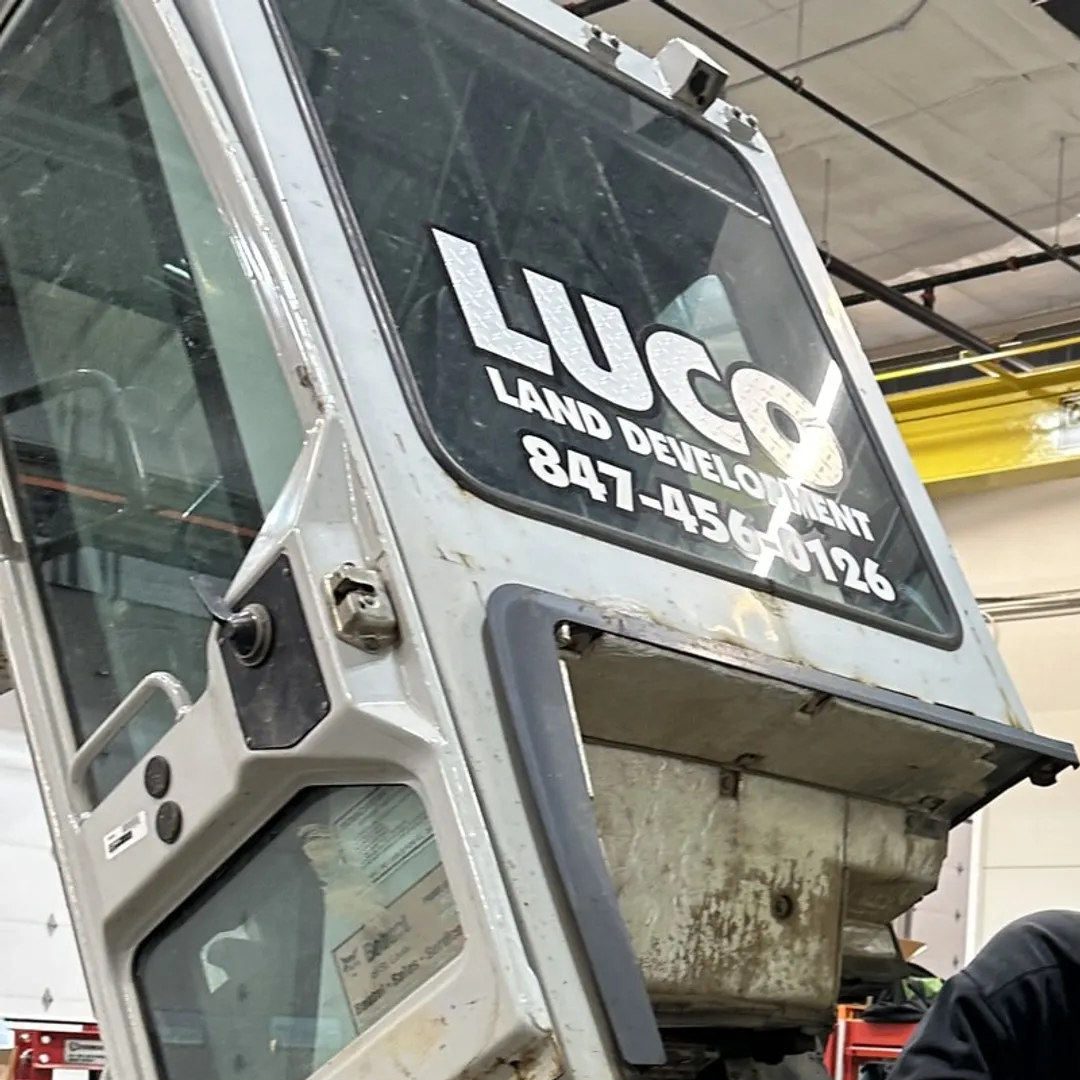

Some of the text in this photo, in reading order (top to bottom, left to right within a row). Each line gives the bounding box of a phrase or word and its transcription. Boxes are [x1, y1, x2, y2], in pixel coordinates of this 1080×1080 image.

[432, 227, 845, 489] LUCO
[486, 366, 875, 542] LAND DEVELOPMENT
[521, 434, 897, 602] 847-456-0126
